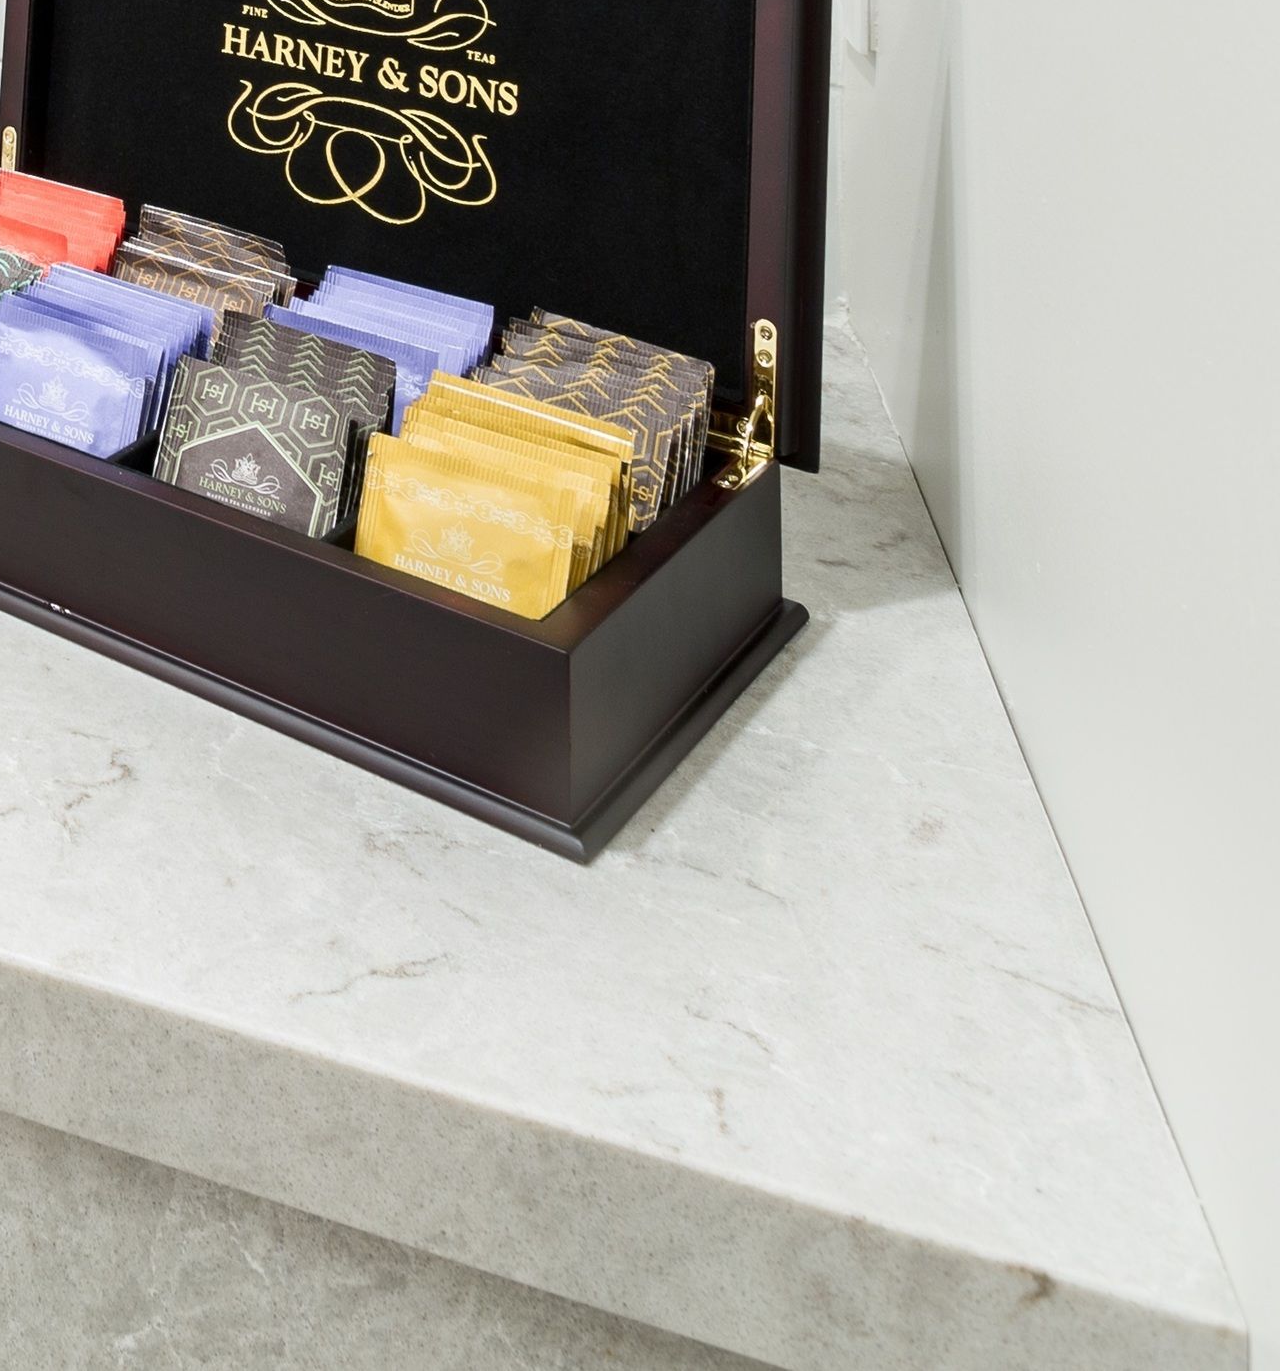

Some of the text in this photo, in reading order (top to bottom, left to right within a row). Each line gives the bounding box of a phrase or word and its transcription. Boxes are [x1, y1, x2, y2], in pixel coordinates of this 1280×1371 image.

[242, 4, 269, 19] FINE
[221, 23, 519, 117] HARNEY & SONS
[466, 49, 496, 65] TEAS
[3, 404, 95, 445] HARNEY & SONS
[198, 476, 287, 514] HARNEY & SONS
[394, 553, 452, 583] HARNEY
[455, 574, 467, 588] &
[472, 578, 512, 603] SONS
